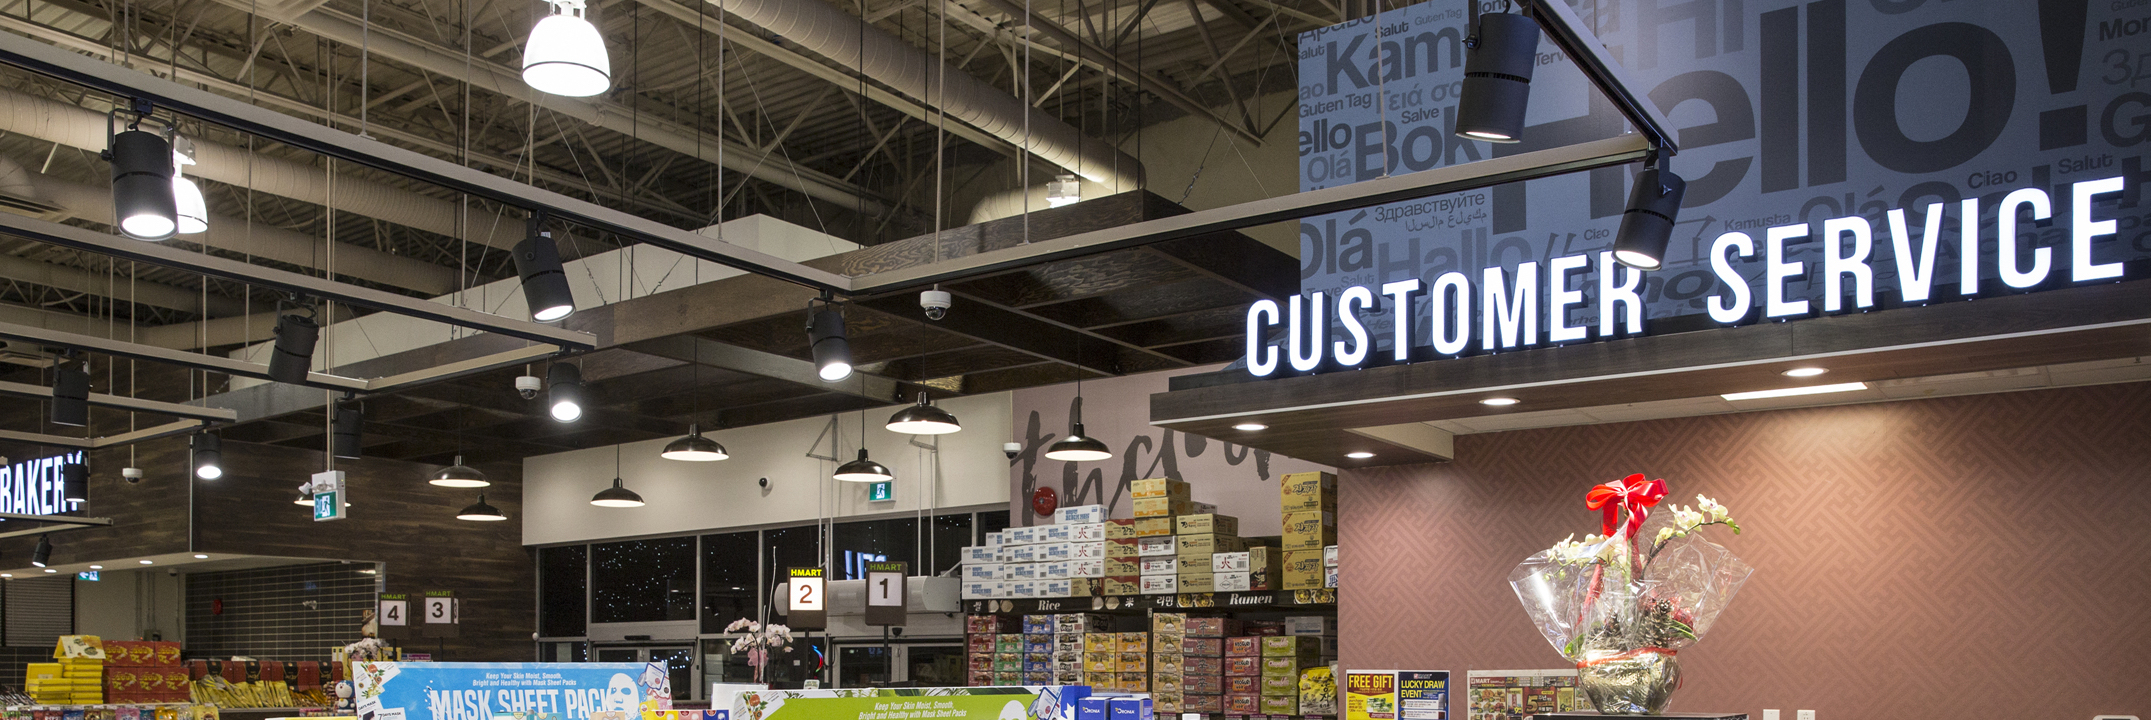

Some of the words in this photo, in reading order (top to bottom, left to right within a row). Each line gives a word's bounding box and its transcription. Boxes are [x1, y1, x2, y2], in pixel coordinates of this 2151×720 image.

[1415, 10, 1444, 26] Guten
[1444, 8, 1463, 23] Tag
[1375, 21, 1409, 39] Salut
[1535, 50, 1570, 67] Terv
[1299, 100, 1344, 118] Guten
[1345, 93, 1372, 109] Tag
[1401, 107, 1440, 124] Salve
[1307, 150, 1352, 184] Olá
[2058, 153, 2114, 175] Salut
[1967, 170, 2018, 189] Ciao
[1375, 191, 1485, 223] Здравствуйте
[1725, 213, 1791, 231] Kamusta
[1583, 228, 1610, 241] Ciao
[1246, 250, 1642, 378] CUSTOMER
[1707, 176, 2124, 323] SERVICE
[1340, 273, 1376, 289] Salut
[791, 568, 823, 577] HMART
[870, 563, 902, 571] HMART
[799, 584, 813, 604] 2
[879, 577, 889, 600] 1
[1038, 600, 1061, 611] Rice
[1229, 592, 1273, 605] Ramen
[387, 605, 399, 621] 4
[431, 602, 444, 618] 3
[1348, 675, 1371, 688] FREE
[1373, 675, 1393, 688] GIFT
[1401, 680, 1423, 689] LUCKY
[1424, 680, 1445, 689] DRAW
[1401, 690, 1423, 698] EVENT
[430, 689, 495, 720] MASK
[874, 702, 889, 711] Keep
[890, 702, 902, 710] Your
[903, 702, 915, 710] Skin
[915, 701, 932, 710] Moist,
[933, 701, 954, 709] Smooth,
[858, 711, 876, 720] Bright
[876, 711, 887, 719] and
[888, 711, 909, 720] Healthy
[909, 711, 921, 719] with
[921, 710, 936, 718] Mask
[936, 709, 952, 717] Sheet
[952, 709, 967, 717] Packs
